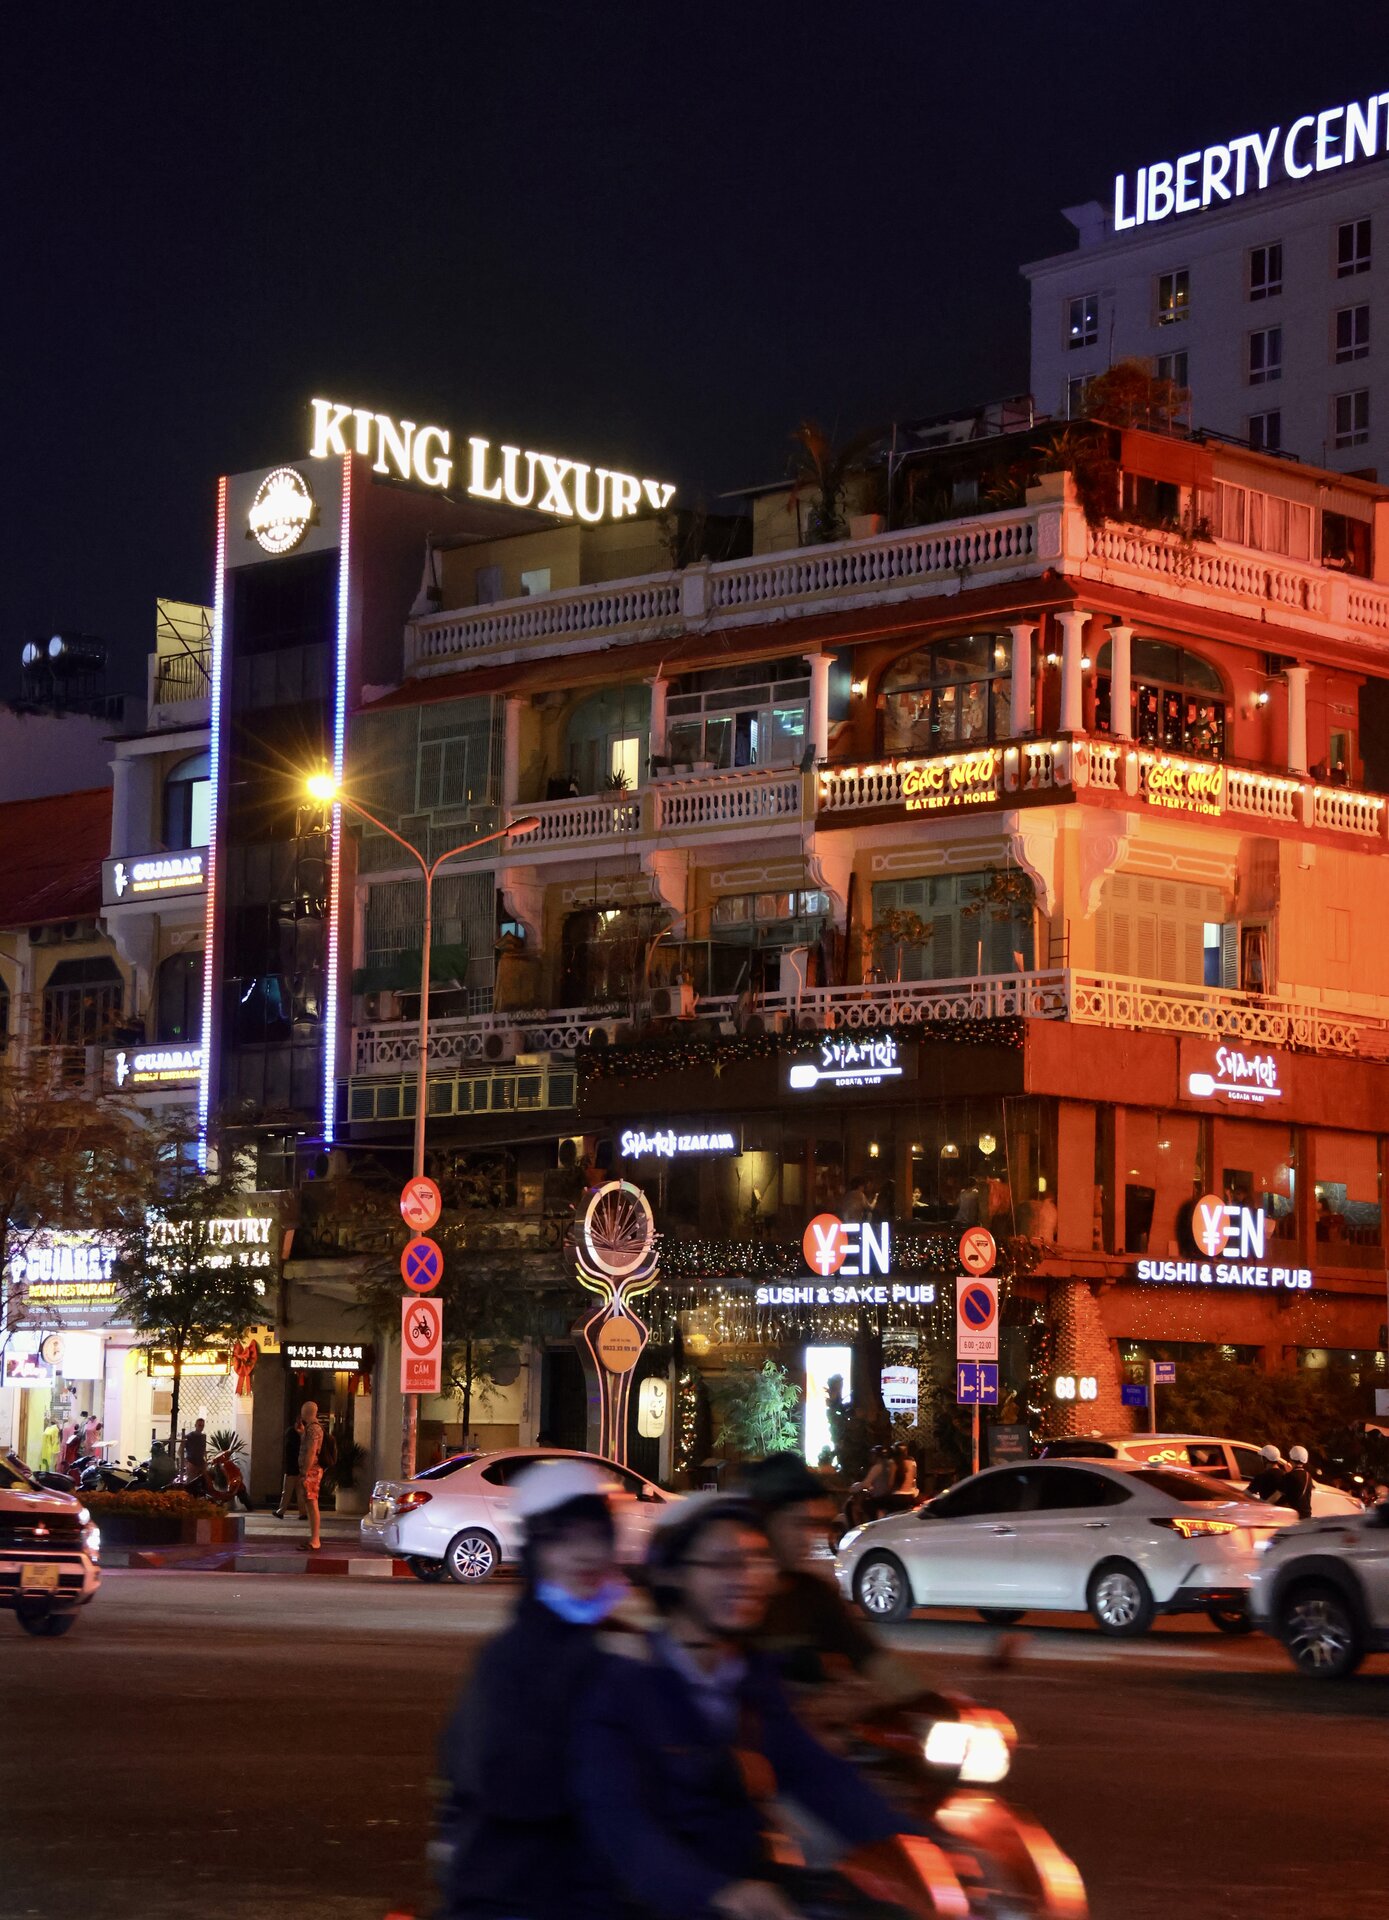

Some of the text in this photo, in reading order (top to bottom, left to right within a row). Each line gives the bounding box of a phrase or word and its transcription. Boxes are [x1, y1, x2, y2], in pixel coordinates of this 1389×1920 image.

[1114, 127, 1280, 231] LIBERTY
[309, 398, 676, 522] KING LUXURY
[905, 797, 951, 811] EATERY
[963, 791, 996, 804] MORE
[1148, 794, 1185, 809] EATERY
[133, 856, 202, 881] GUJARAT
[678, 1133, 734, 1150] IZAKAYA
[1137, 1260, 1312, 1289] SUSHI & SAKE PUB
[58, 1282, 117, 1296] RESTAURANT
[756, 1285, 935, 1304] SUSHI & SAKE PUB
